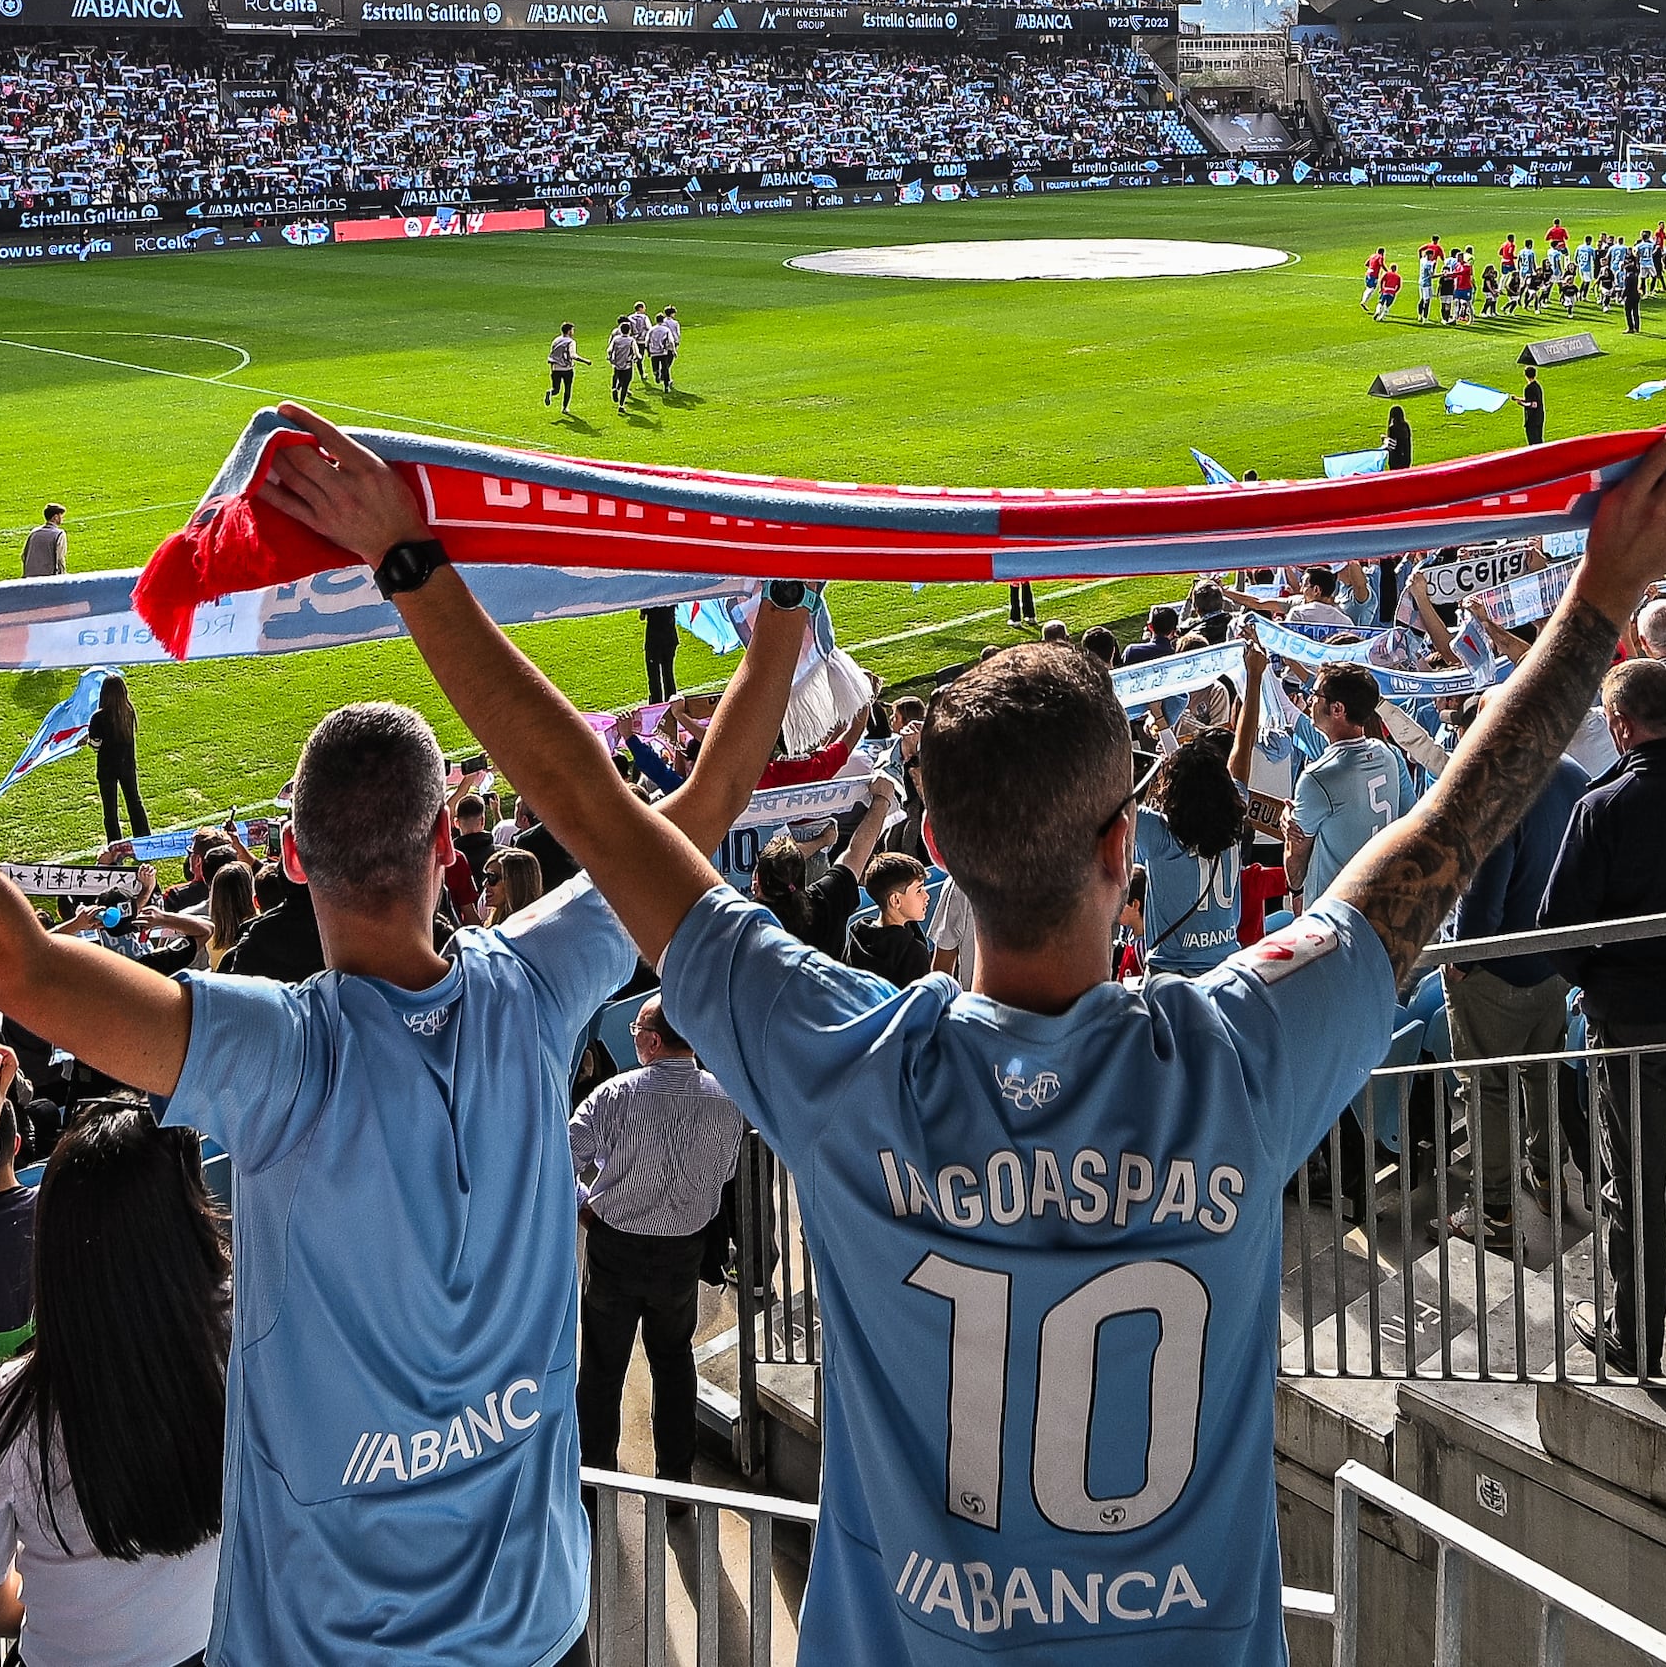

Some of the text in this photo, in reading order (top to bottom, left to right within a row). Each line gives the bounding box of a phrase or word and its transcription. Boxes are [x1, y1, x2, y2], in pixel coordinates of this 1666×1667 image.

[362, 1, 481, 24] Estrella Galicia
[633, 6, 695, 27] Recalvi
[775, 8, 848, 21] AIX INVESTMENT
[797, 20, 826, 31] GROUP
[862, 12, 943, 30] Estrella Galicia
[1107, 17, 1169, 28] 1923 2023
[866, 167, 903, 183] Recalvi
[934, 164, 968, 177] GADIS
[1071, 161, 1143, 175] Estrella Galici
[1387, 174, 1421, 183] FOLLOW
[534, 181, 616, 197] Estrella Galicia
[806, 194, 844, 208] RCelta
[647, 202, 689, 217] RCCelta
[20, 206, 137, 229] Estrella Galicia
[25, 245, 44, 258] US
[1366, 773, 1395, 833] 5
[904, 1252, 1212, 1534] 10
[342, 1379, 541, 1487] //ABANC
